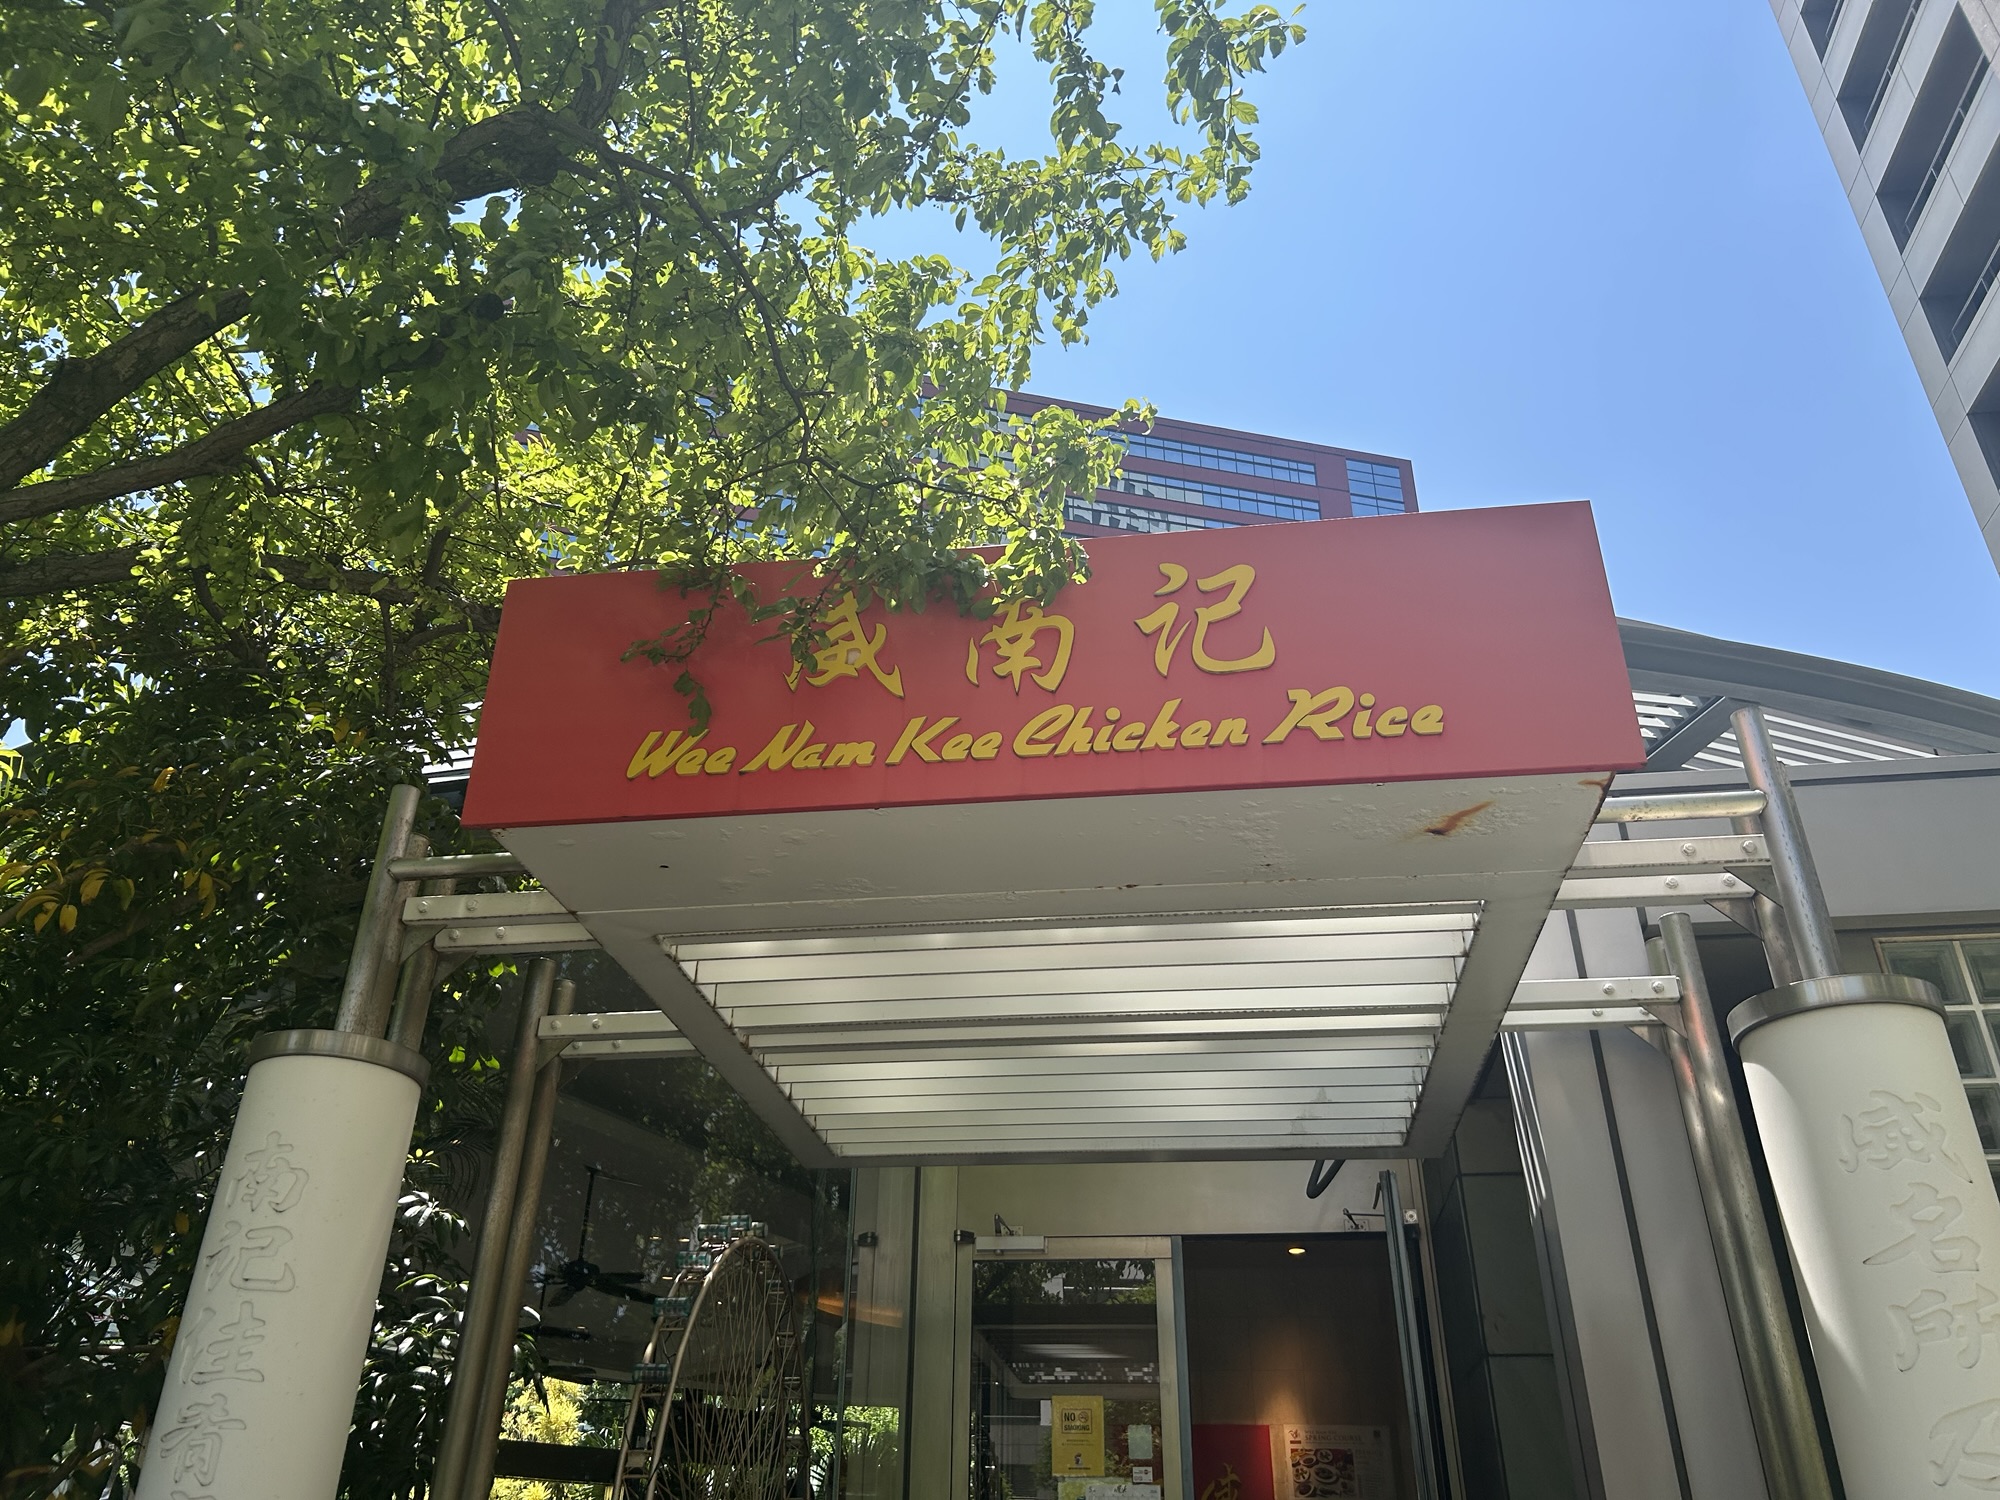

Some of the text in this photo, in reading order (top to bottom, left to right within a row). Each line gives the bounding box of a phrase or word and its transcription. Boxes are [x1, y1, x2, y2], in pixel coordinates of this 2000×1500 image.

[783, 563, 1276, 699] 威南记
[627, 685, 1444, 779] Wee Nam Kee Chicken Rice
[1064, 1412, 1076, 1422] NO
